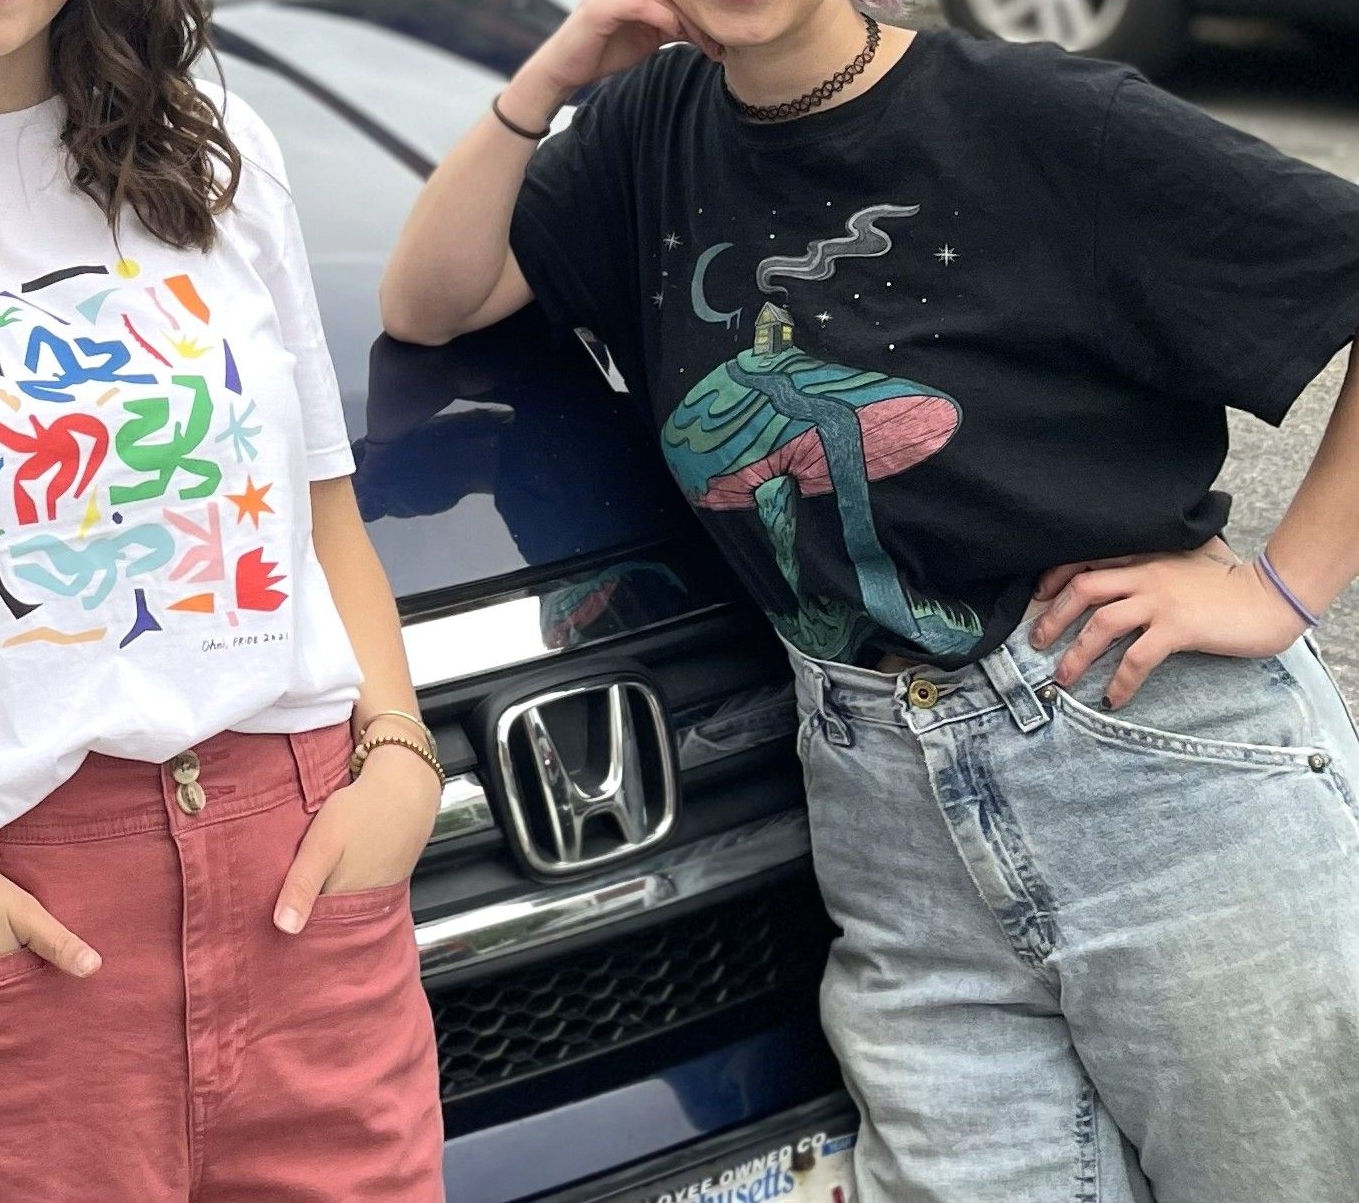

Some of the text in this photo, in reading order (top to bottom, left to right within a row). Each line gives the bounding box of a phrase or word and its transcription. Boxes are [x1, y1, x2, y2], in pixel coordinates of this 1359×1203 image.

[233, 635, 258, 647] PRIDE
[263, 632, 289, 642] 2021
[655, 1177, 713, 1203] OYEE
[719, 1145, 792, 1187] OWNED
